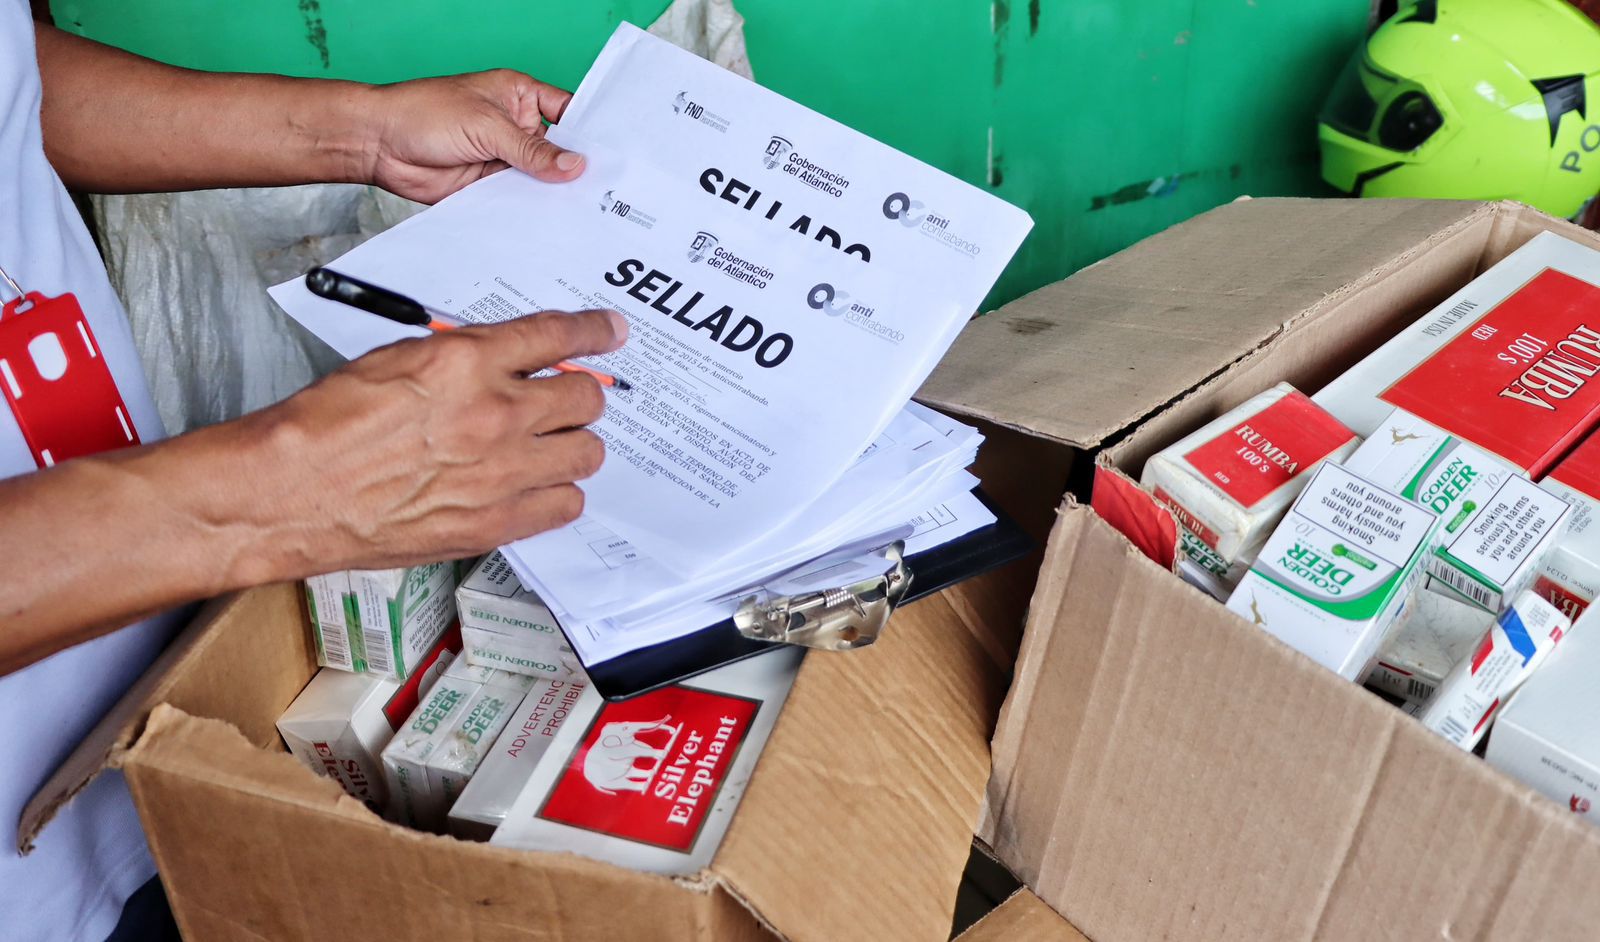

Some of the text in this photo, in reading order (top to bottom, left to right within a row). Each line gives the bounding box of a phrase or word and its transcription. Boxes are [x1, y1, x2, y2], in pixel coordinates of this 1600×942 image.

[684, 101, 704, 120] FND
[783, 163, 843, 198] del Atlántico
[789, 152, 850, 189] Gobernación
[611, 200, 631, 218] FND
[926, 213, 950, 230] anti
[921, 221, 981, 256] contrabando
[707, 257, 767, 290] del Atlántico
[714, 246, 774, 281] Gobernación
[494, 276, 524, 298] Conforme
[468, 304, 499, 325] DEPART
[478, 296, 520, 322] APREHEN
[485, 292, 530, 321] APREHENS
[604, 258, 794, 369] SELLADO
[851, 303, 875, 318] anti
[1420, 298, 1479, 338] MADE IN USA
[555, 278, 567, 288] Art.
[632, 325, 643, 333] 06
[651, 337, 669, 349] Julio
[678, 352, 698, 365] 2015
[696, 362, 710, 373] Ley
[710, 371, 768, 406] Anticontrabando.
[593, 292, 613, 305] Cierre
[611, 304, 644, 323] temporal
[651, 327, 702, 357] establecimiento
[702, 355, 712, 363] de
[712, 361, 743, 380] comercio
[846, 311, 905, 342] contrabando
[1471, 324, 1499, 341] RED
[637, 338, 664, 356] Numero
[619, 358, 631, 366] 24
[626, 364, 642, 374] Ley
[643, 372, 662, 386] 1762
[721, 422, 770, 453] sancionatorio
[602, 403, 655, 438] BLECIMIENTO
[655, 436, 674, 450] POR
[672, 448, 684, 458] EL
[686, 456, 723, 481] TERMINO
[722, 480, 738, 490] DE
[636, 405, 670, 427] QUEDAN
[684, 435, 736, 469] DISPOSICION
[739, 469, 756, 483] DEL
[658, 401, 718, 440] RELACIONADOS
[718, 439, 733, 449] EN
[732, 448, 755, 464] ACTA
[756, 462, 771, 473] DE
[1234, 424, 1299, 475] RUMBA
[613, 438, 634, 454] PARA
[634, 452, 646, 462] LA
[646, 460, 695, 491] IMPOSICION
[694, 490, 709, 501] DE
[708, 499, 720, 509] LA
[623, 425, 638, 436] DE
[636, 434, 648, 444] LA
[649, 442, 697, 474] RESPECTIVA
[698, 473, 737, 498] SANCION
[717, 448, 752, 470] AVALUO
[1236, 446, 1270, 474] 100's
[1214, 471, 1231, 485] RED
[1420, 456, 1464, 504] GOLDEN
[1430, 464, 1479, 516] DEER
[1330, 487, 1407, 531] you and others
[1346, 481, 1403, 515] around you
[1321, 496, 1401, 542] seriously harms
[1331, 516, 1376, 545] Smoking
[1473, 501, 1510, 536] Smoking
[1476, 494, 1530, 556] seriously harms
[1488, 504, 1540, 562] you and others
[1506, 517, 1546, 560] around you
[482, 561, 495, 574] you
[487, 561, 507, 582] others
[1277, 556, 1342, 596] GOLDEN
[1286, 542, 1355, 586] DEER
[413, 604, 449, 652] you and others
[417, 596, 440, 624] Smoking
[470, 608, 555, 634] GOLDEN DEER
[410, 615, 432, 645] seriously
[419, 617, 446, 653] around you
[472, 647, 502, 661] DEER
[505, 655, 557, 673] GOLDEN
[412, 687, 450, 731] GOLDEN
[421, 690, 463, 735] DEER
[461, 695, 491, 733] OLDEN
[466, 697, 506, 745] DEER
[507, 680, 566, 758] ADVERTENC
[541, 684, 586, 737] PROHIBI
[654, 729, 704, 801] Silver
[666, 715, 738, 828] Elephant
